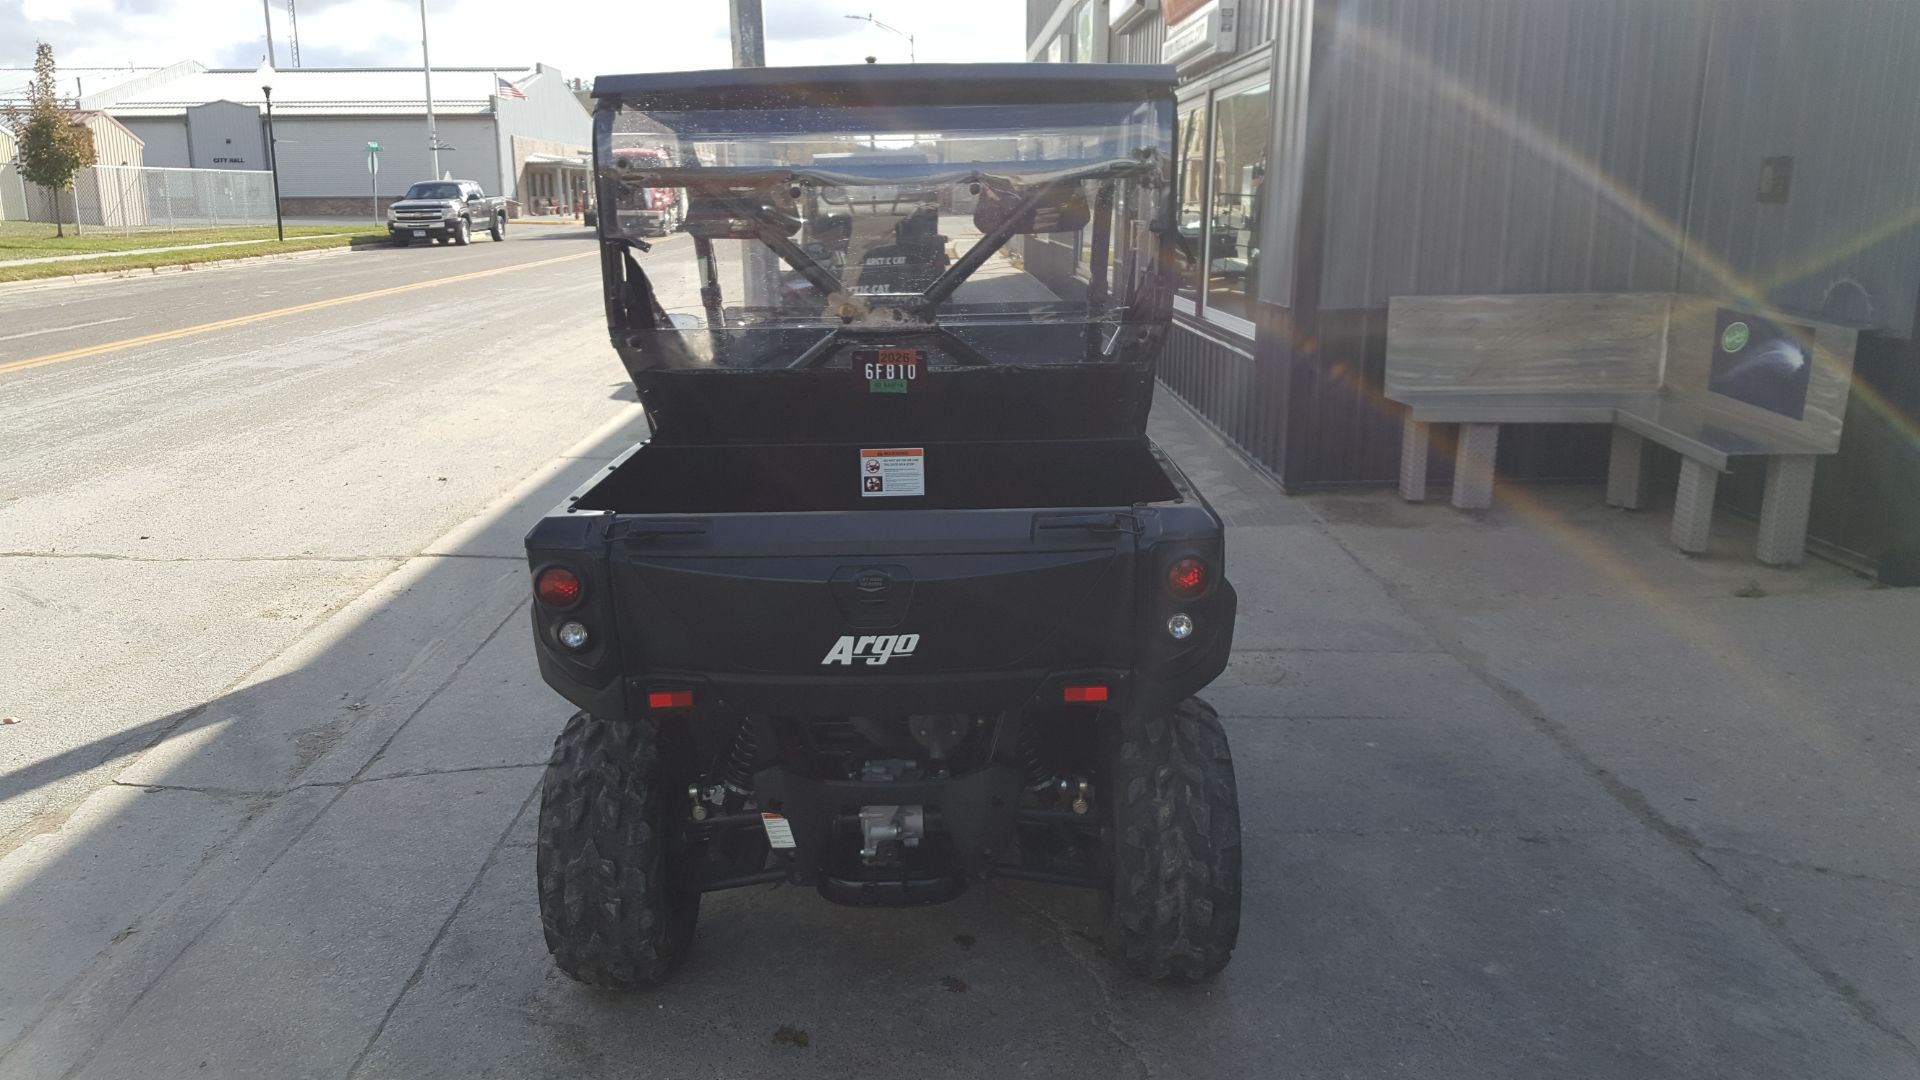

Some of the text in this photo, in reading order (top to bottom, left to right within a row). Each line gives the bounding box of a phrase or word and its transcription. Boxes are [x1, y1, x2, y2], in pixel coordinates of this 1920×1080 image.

[892, 256, 907, 265] CAT
[871, 284, 890, 294] CAT
[880, 352, 910, 363] 2026
[865, 363, 916, 380] 6FB10
[821, 633, 920, 665] Argo
